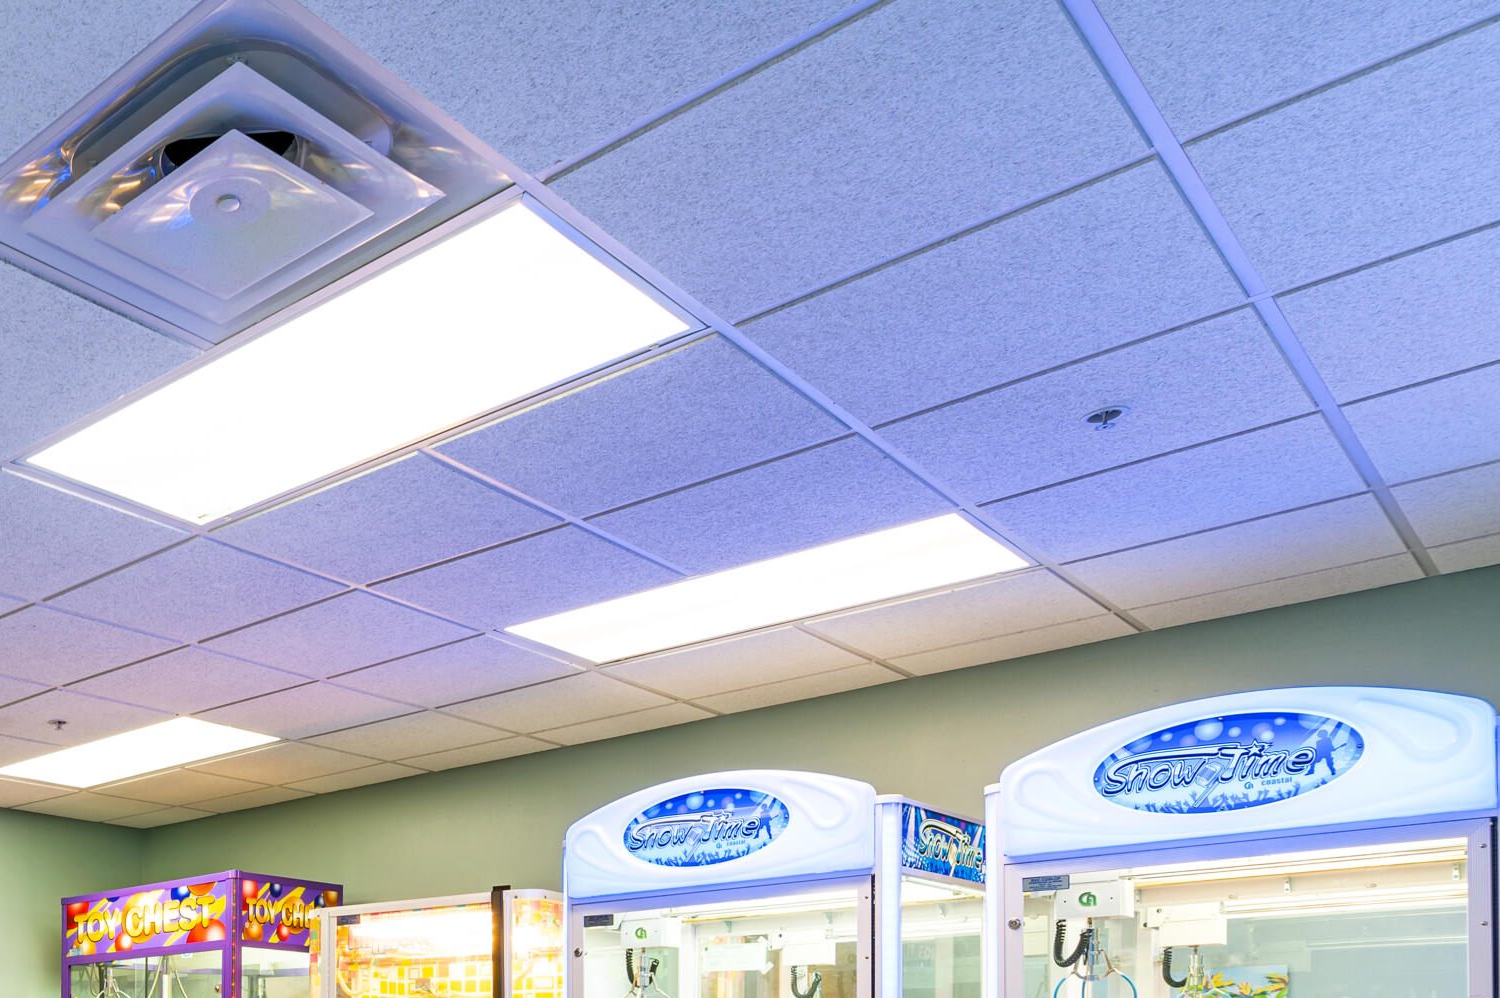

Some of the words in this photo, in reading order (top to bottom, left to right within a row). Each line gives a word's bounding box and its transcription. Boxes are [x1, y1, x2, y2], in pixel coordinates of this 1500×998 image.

[1217, 742, 1316, 783] Time
[1261, 776, 1293, 786] coastal
[700, 812, 761, 843] Time
[73, 909, 119, 944] TOY
[124, 895, 216, 938] CHEST
[245, 897, 278, 925] TOY
